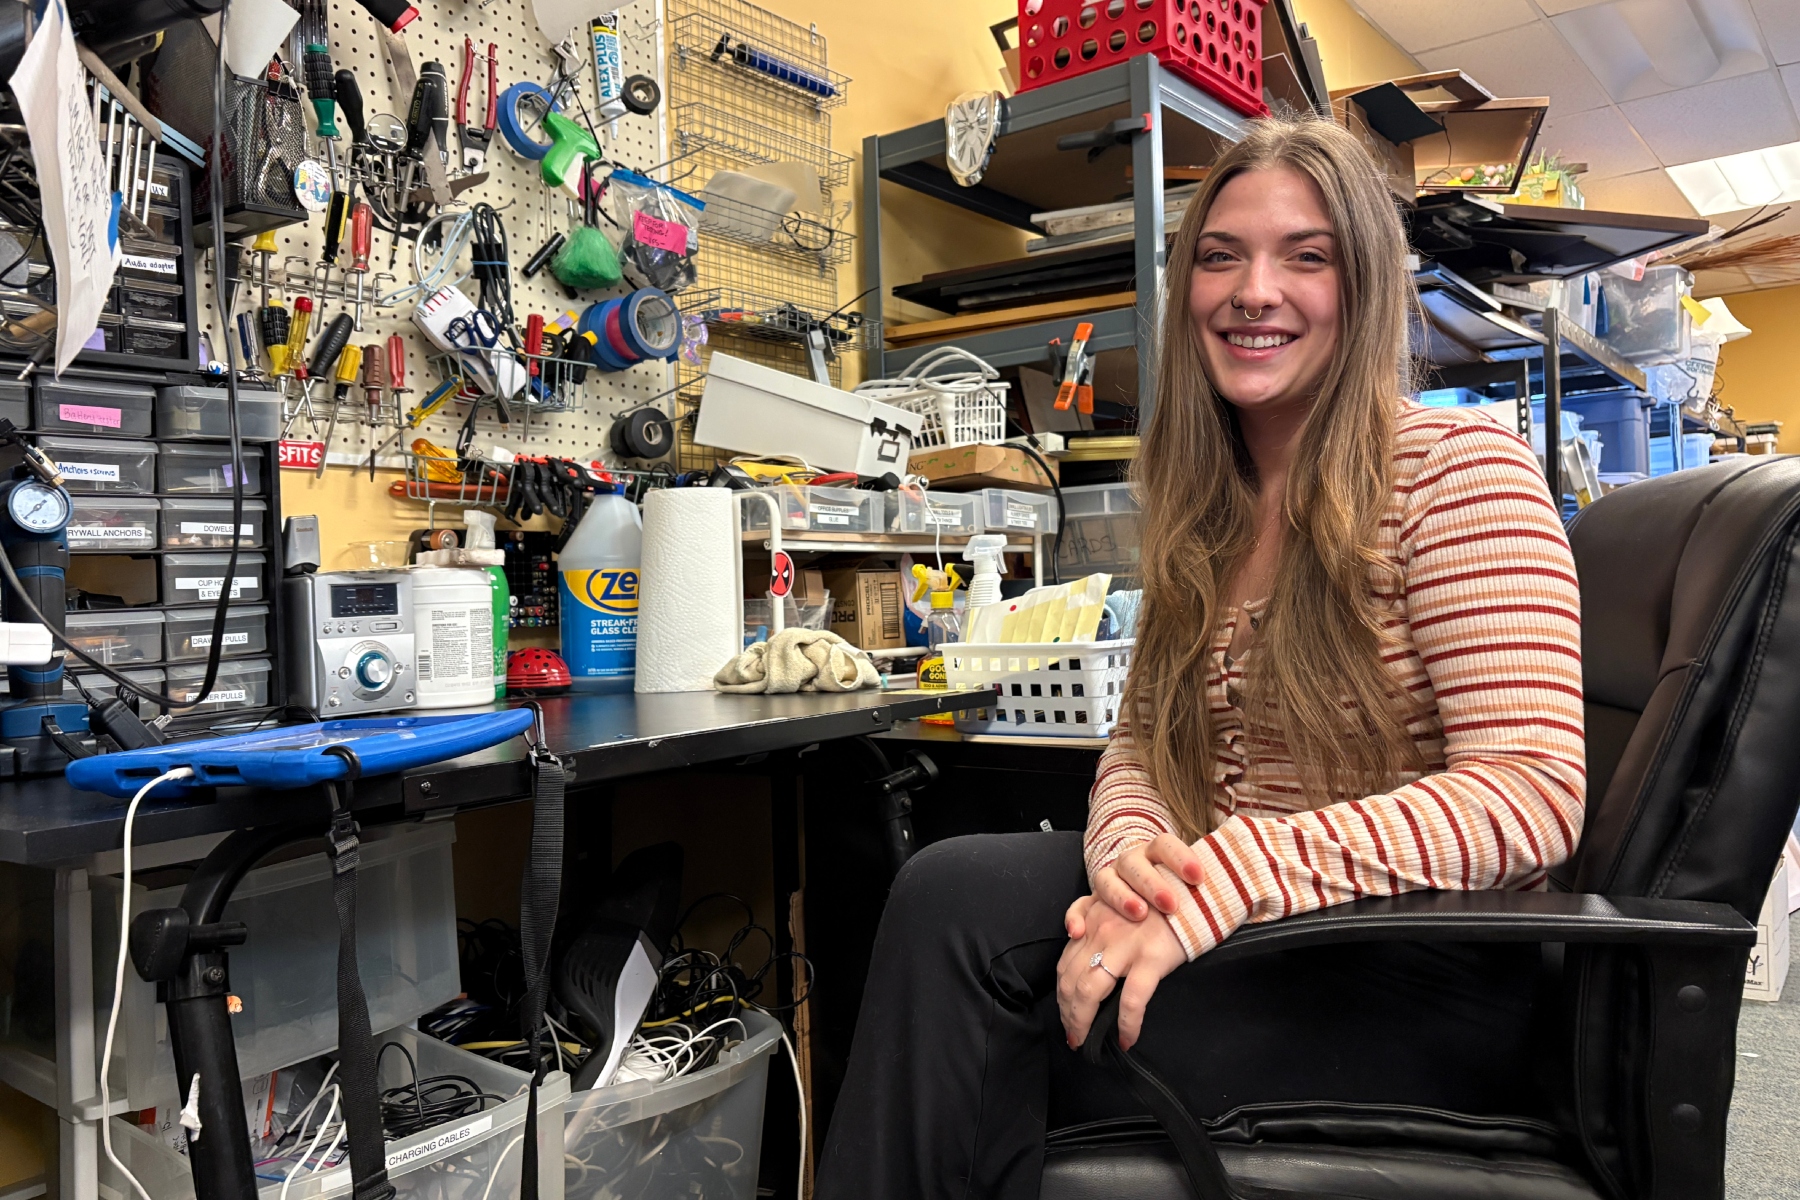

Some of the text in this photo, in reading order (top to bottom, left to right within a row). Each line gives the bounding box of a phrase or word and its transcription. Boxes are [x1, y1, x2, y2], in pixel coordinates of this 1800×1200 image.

[594, 35, 611, 98] ALEX PLUS
[125, 258, 147, 269] Audio
[58, 463, 88, 475] Anchors
[1059, 535, 1117, 559] CARDS
[214, 578, 239, 586] HOS
[600, 571, 640, 600] Ze
[864, 578, 872, 616] PROCELL
[590, 626, 620, 636] GLASS
[225, 635, 247, 643] PULLS
[221, 692, 243, 700] PULLS
[388, 1128, 471, 1166] CHARGING CABLES
